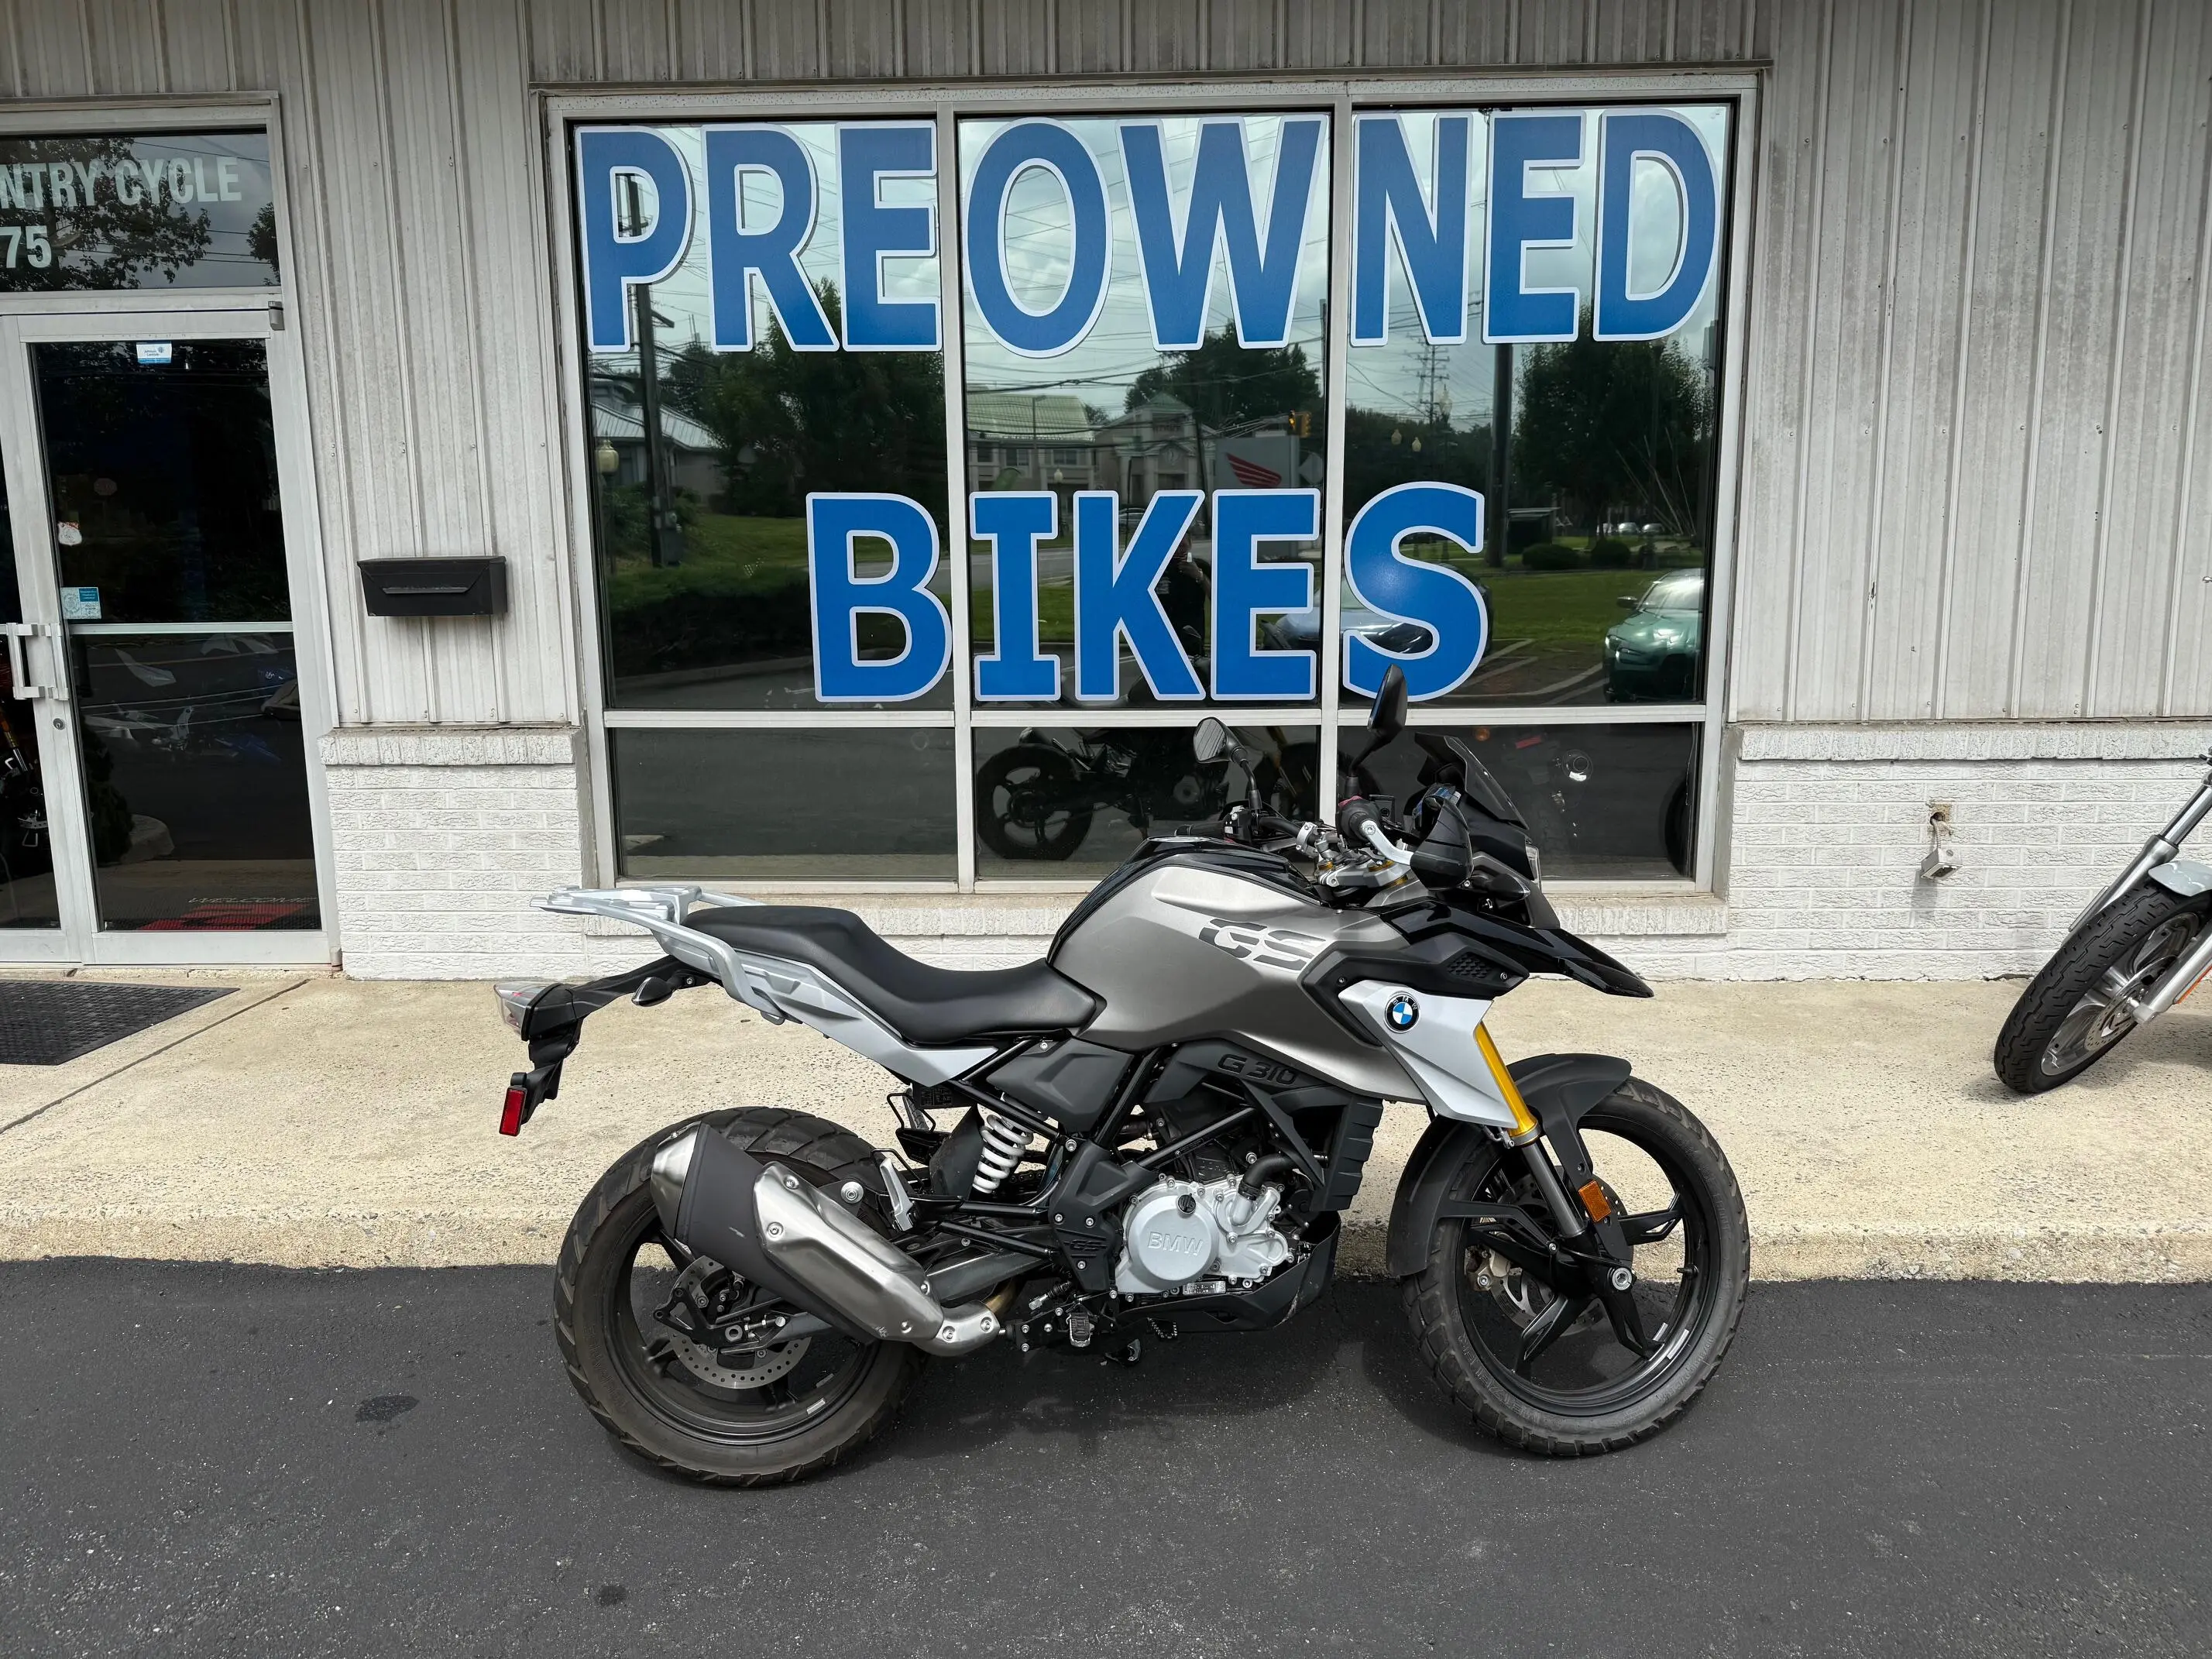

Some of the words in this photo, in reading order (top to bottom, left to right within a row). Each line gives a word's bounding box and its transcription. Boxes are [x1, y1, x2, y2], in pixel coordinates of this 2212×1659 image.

[115, 157, 242, 205] CYCLE
[575, 108, 1721, 358] PREOWNED
[806, 481, 1489, 702] BIKES
[1198, 918, 1327, 972] GS
[1392, 994, 1418, 1011] BMW
[1218, 1053, 1247, 1074] G
[1246, 1060, 1297, 1084] 310
[1147, 1231, 1204, 1256] BMW
